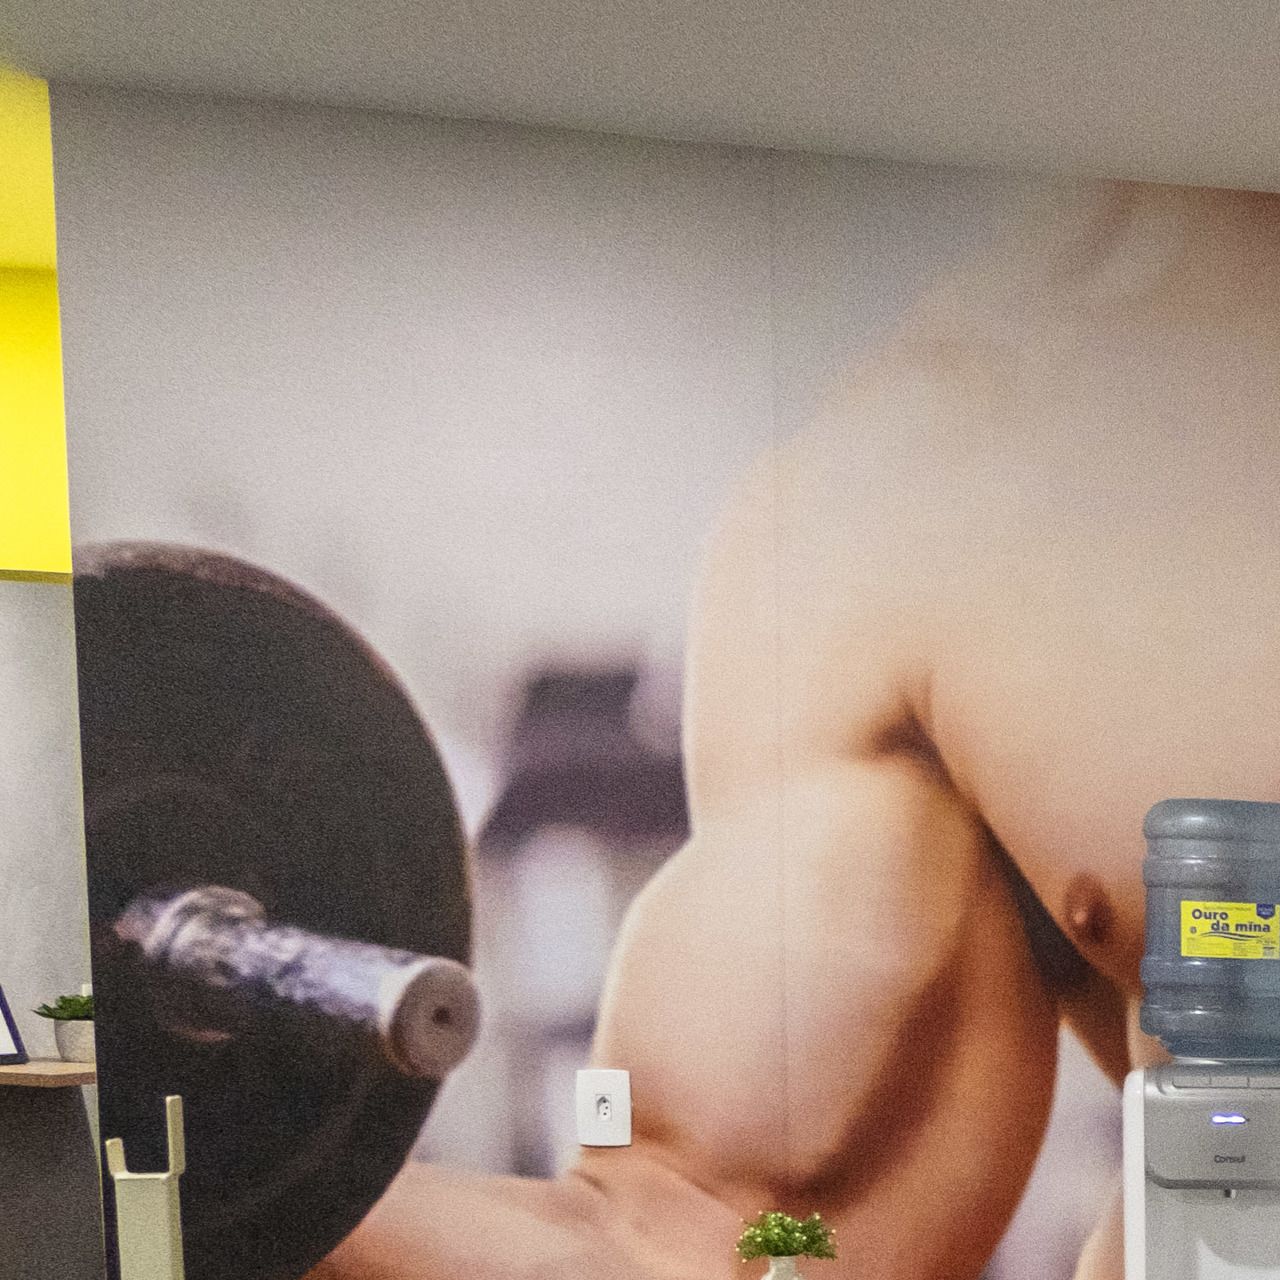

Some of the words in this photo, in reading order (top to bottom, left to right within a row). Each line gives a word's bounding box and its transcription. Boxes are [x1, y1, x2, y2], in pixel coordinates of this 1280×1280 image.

[1191, 908, 1229, 920] Ouro
[1211, 919, 1230, 932] da
[1235, 921, 1271, 933] mina
